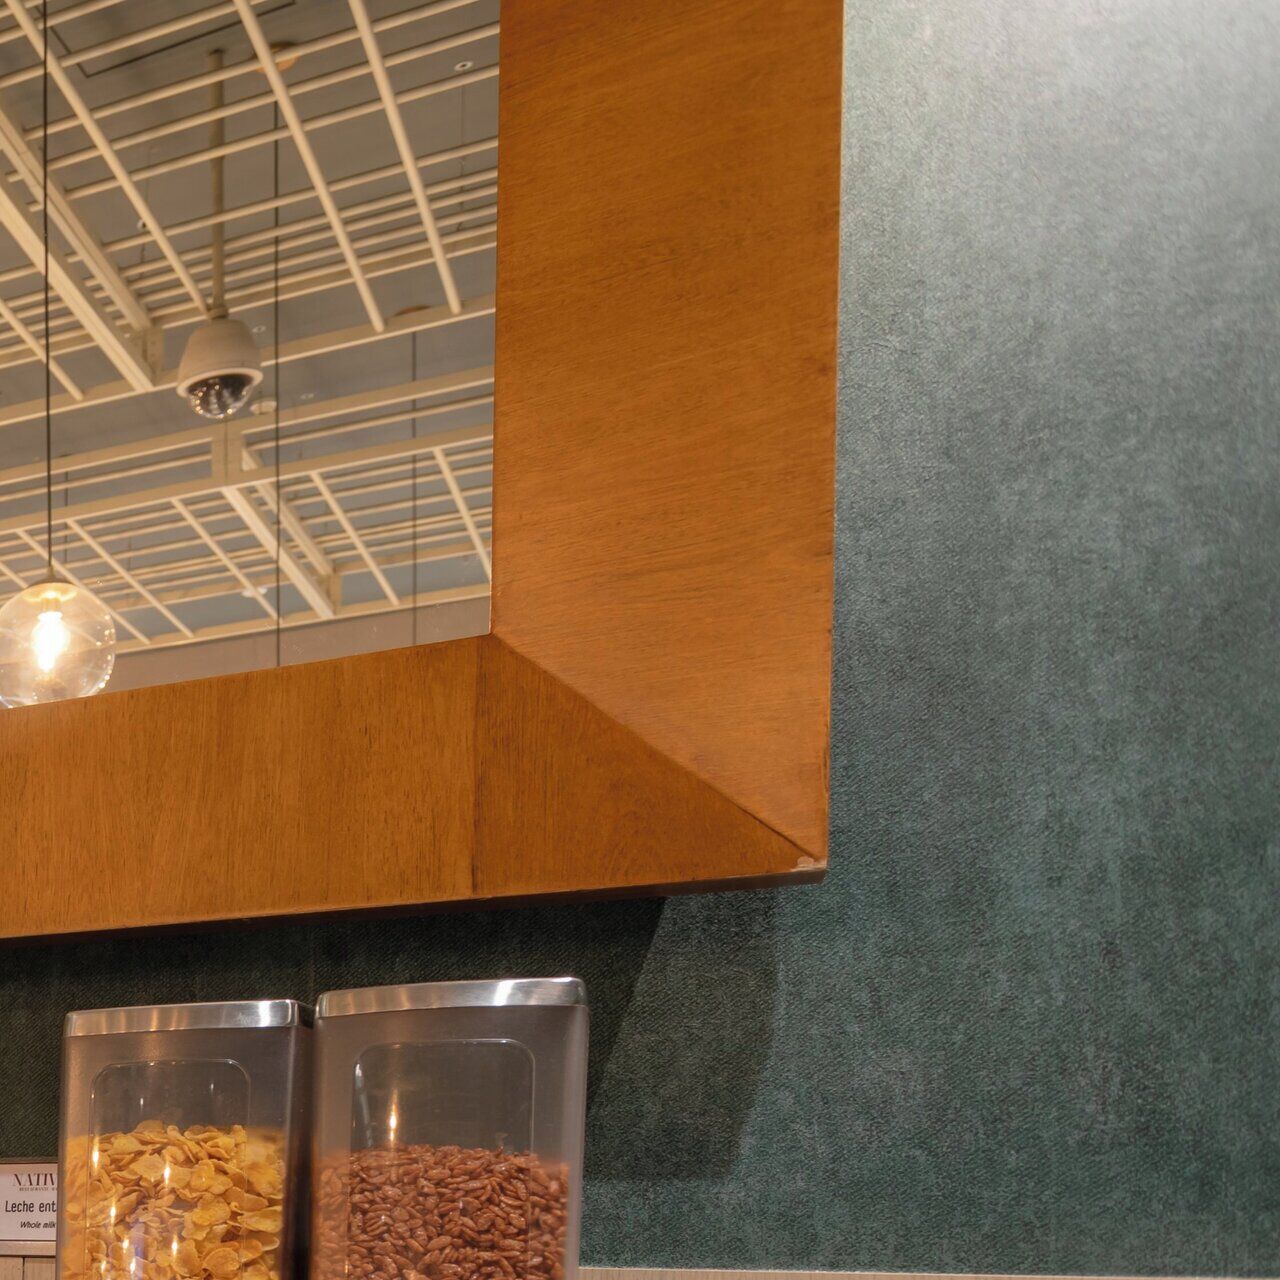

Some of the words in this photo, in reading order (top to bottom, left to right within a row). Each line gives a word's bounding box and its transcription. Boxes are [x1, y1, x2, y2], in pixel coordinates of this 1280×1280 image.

[12, 1173, 58, 1187] NATIV
[5, 1200, 34, 1213] Leche
[20, 1221, 41, 1229] Whole
[42, 1221, 57, 1229] milk
